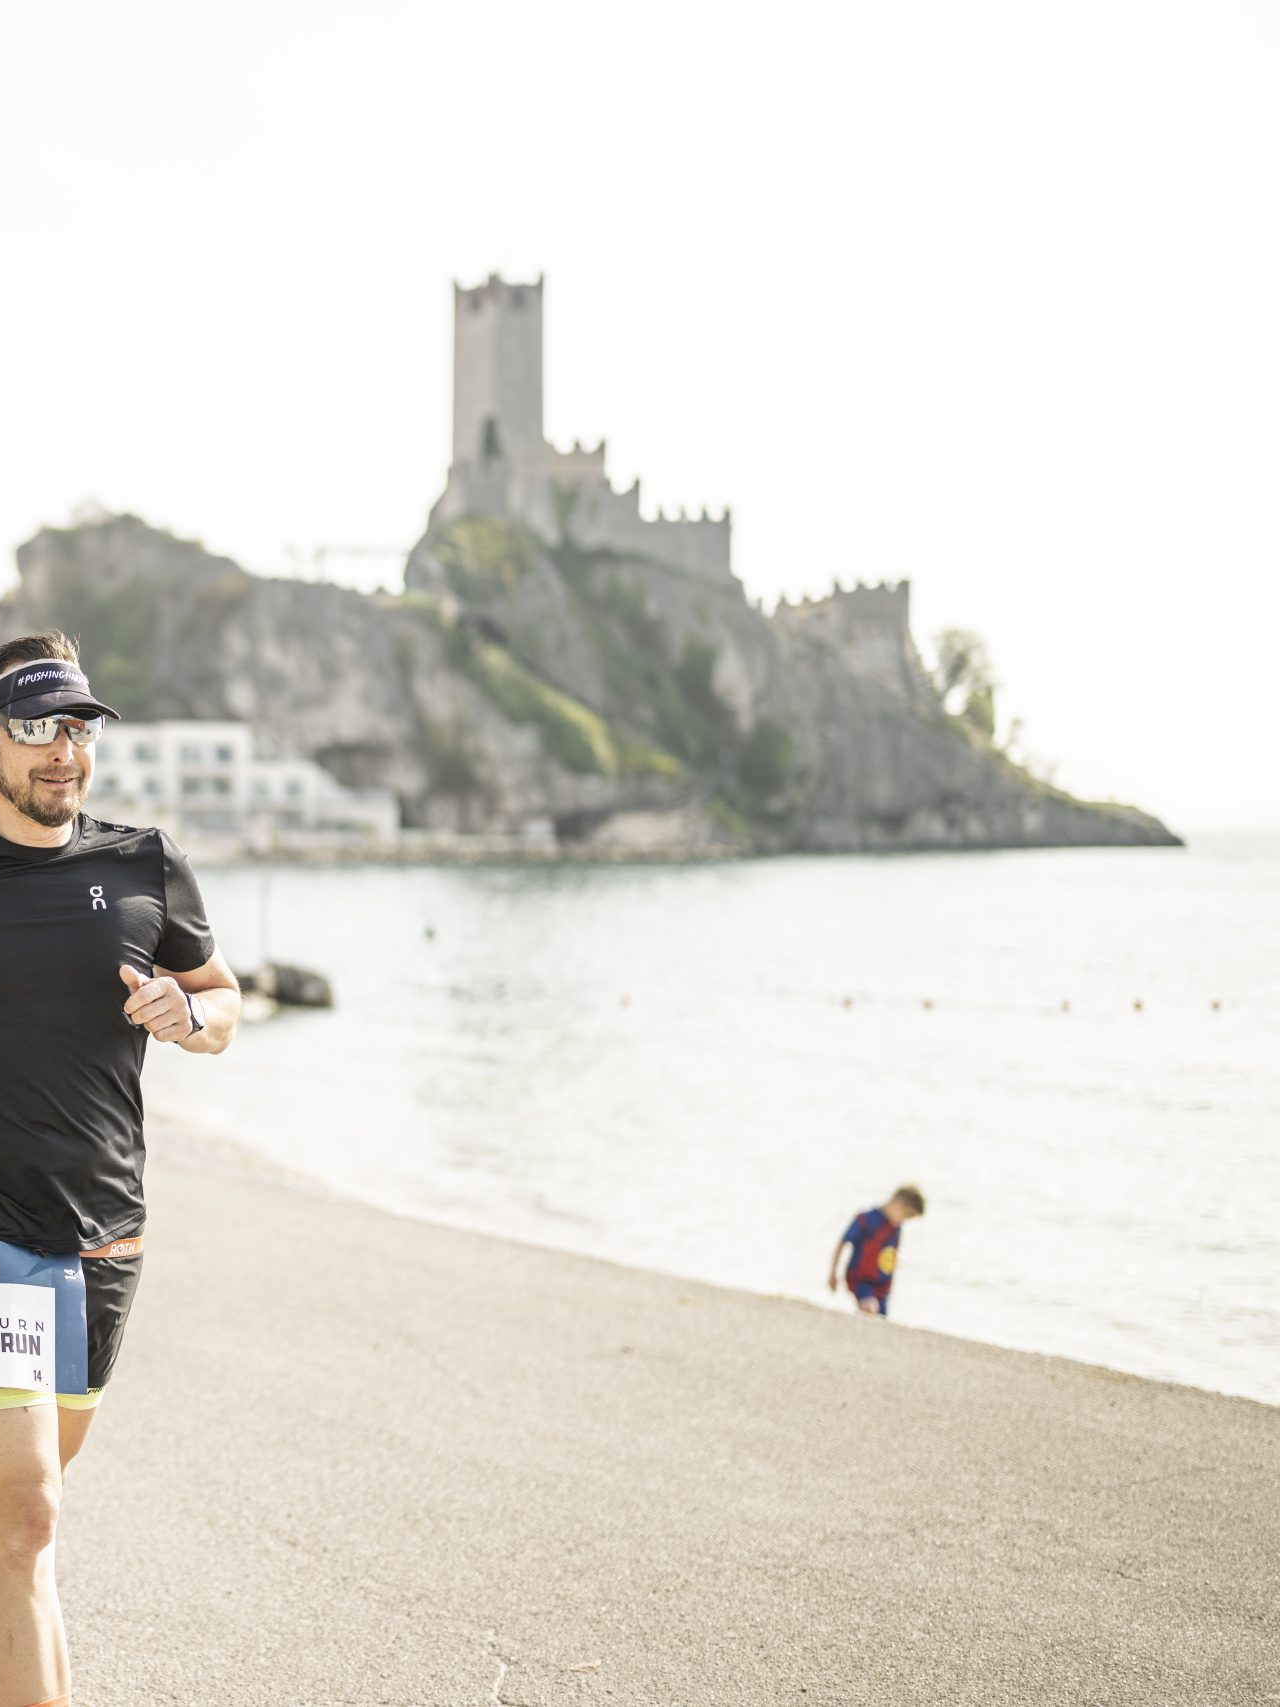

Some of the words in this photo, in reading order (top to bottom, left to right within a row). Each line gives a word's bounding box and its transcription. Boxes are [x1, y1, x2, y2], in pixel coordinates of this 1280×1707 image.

[109, 1242, 136, 1256] ROTH
[1, 1332, 41, 1356] RUN
[33, 1369, 42, 1382] 14
